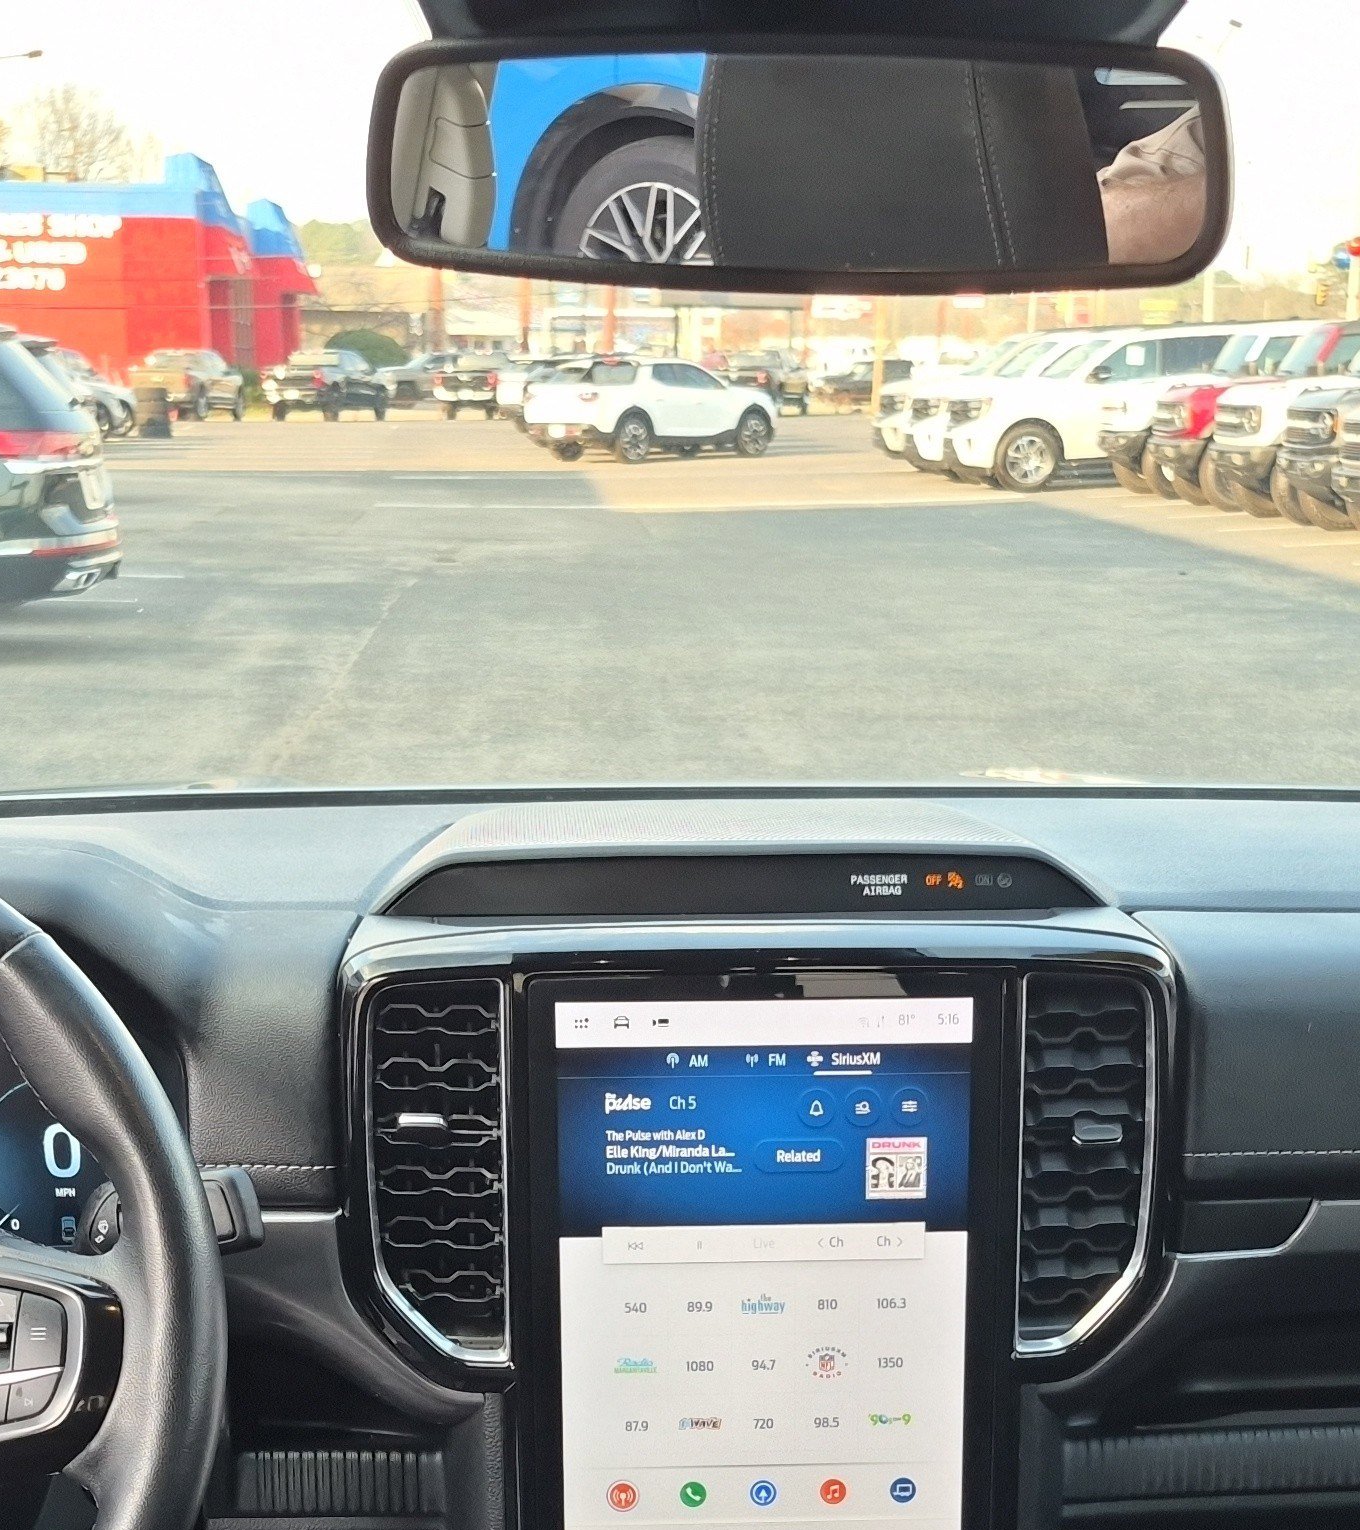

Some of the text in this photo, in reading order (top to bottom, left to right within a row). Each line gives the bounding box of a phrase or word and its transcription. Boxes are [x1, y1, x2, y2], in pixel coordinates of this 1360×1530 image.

[850, 874, 908, 885] PASSENGER
[926, 874, 942, 886] OFF
[862, 886, 902, 896] AIRBAG
[937, 1012, 960, 1026] 5:16
[688, 1054, 709, 1068] AM
[768, 1053, 786, 1067] FM
[831, 1051, 881, 1066] SiriusXM
[669, 1096, 685, 1109] Ch
[688, 1096, 696, 1109] 5
[606, 1129, 706, 1141] The Pulse with Alex D
[43, 1123, 81, 1178] 0
[871, 1141, 922, 1149] DRUNK
[606, 1145, 628, 1158] Elle
[630, 1144, 709, 1160] King/Miranda
[776, 1149, 821, 1163] Related
[606, 1162, 641, 1175] Drunk
[643, 1161, 672, 1176] (And
[680, 1161, 712, 1173] Don't
[55, 1187, 76, 1198] MPH
[10, 1218, 20, 1231] 0
[753, 1238, 775, 1250] Live
[829, 1236, 844, 1248] Ch
[876, 1235, 891, 1248] Ch
[624, 1302, 647, 1314] 540
[687, 1301, 713, 1313] 89.9
[741, 1299, 785, 1314] highway
[817, 1299, 838, 1311] 810
[876, 1298, 907, 1310] 106.3
[686, 1360, 714, 1372] 1080
[751, 1359, 776, 1371] 94.7
[877, 1357, 903, 1369] 1350
[625, 1420, 648, 1432] 87.9
[753, 1418, 774, 1430] 720
[814, 1417, 839, 1429] 98.5
